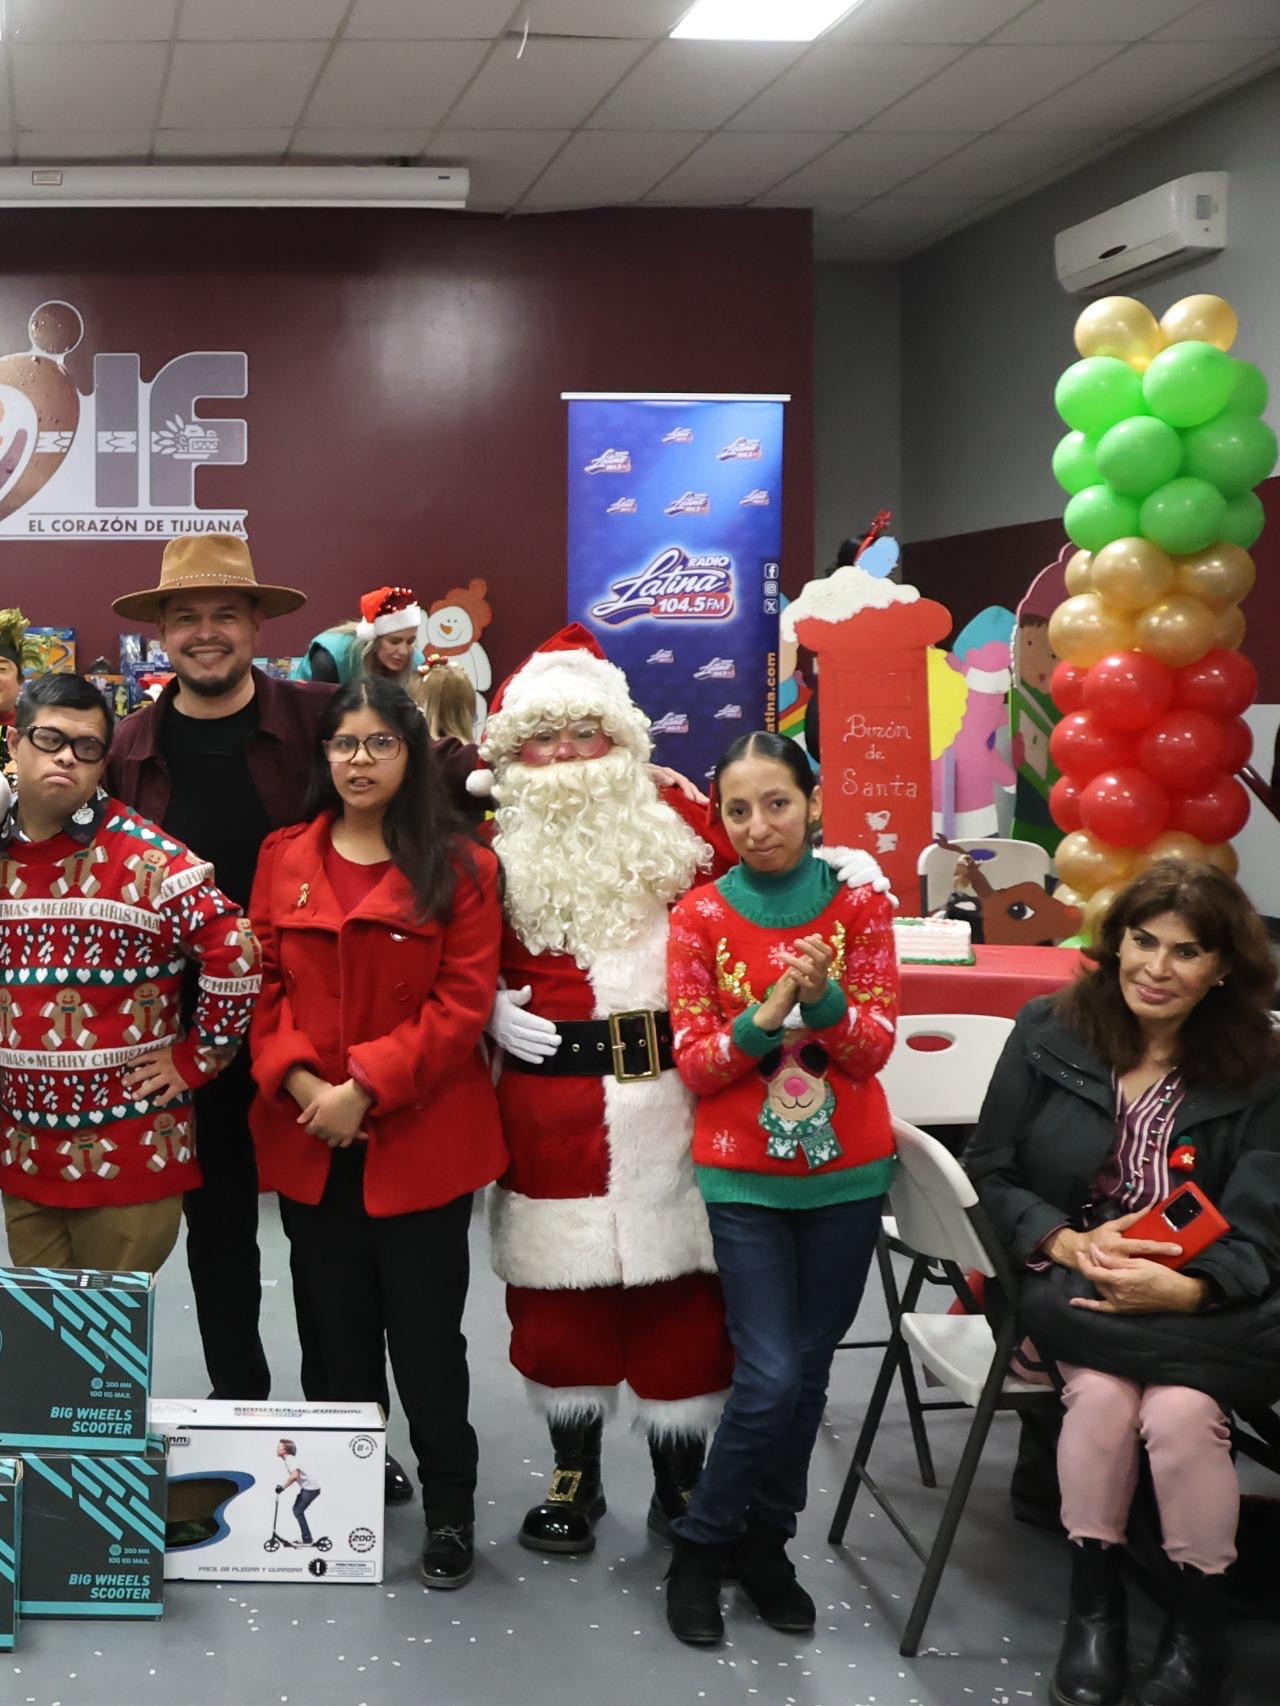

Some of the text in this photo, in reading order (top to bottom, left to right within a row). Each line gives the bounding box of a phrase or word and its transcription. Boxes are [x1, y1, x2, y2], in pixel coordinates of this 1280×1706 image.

[28, 515, 245, 533] EL CORAZÓN DE TIJUANA
[687, 555, 730, 568] RADIO
[591, 548, 726, 617] Latina
[842, 768, 918, 798] Santa
[38, 902, 88, 917] MERRY
[35, 1054, 88, 1069] MERRY
[50, 1406, 133, 1421] BIG WHEELS
[71, 1421, 133, 1435] SCOOTER
[352, 1534, 372, 1542] 200
[69, 1573, 151, 1586] BIG WHEELS
[90, 1587, 151, 1600] SCOOTER
